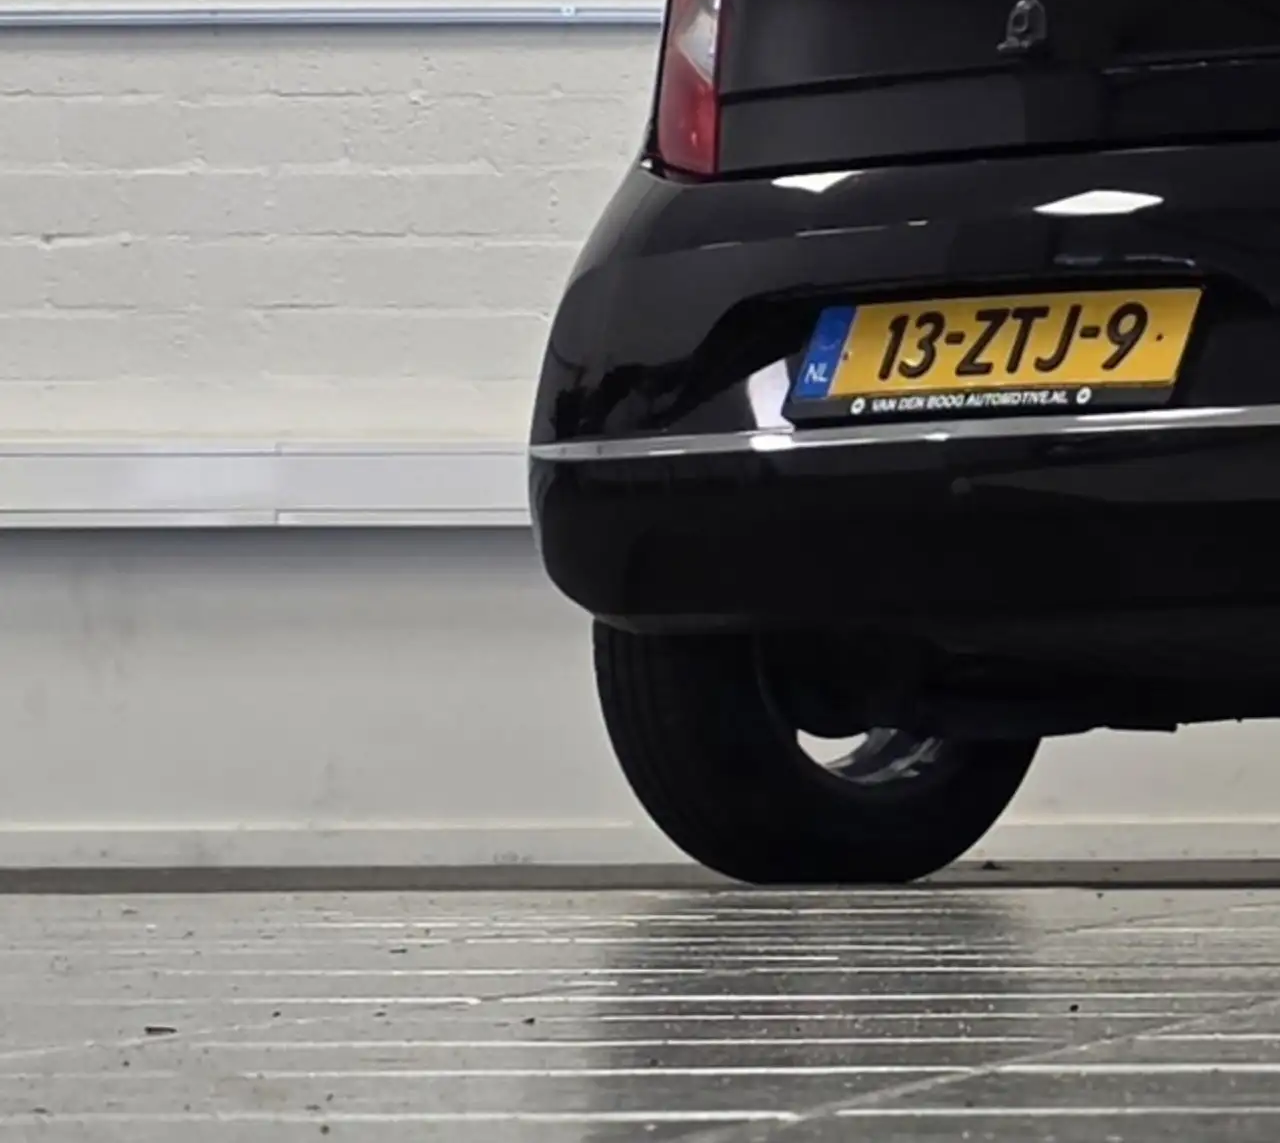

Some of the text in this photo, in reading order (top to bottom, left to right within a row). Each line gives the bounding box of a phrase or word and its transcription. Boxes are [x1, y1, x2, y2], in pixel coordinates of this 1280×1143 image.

[804, 301, 1148, 385] NL 13-ZTJ-9
[871, 398, 896, 413] VAN
[898, 396, 926, 411] DEN
